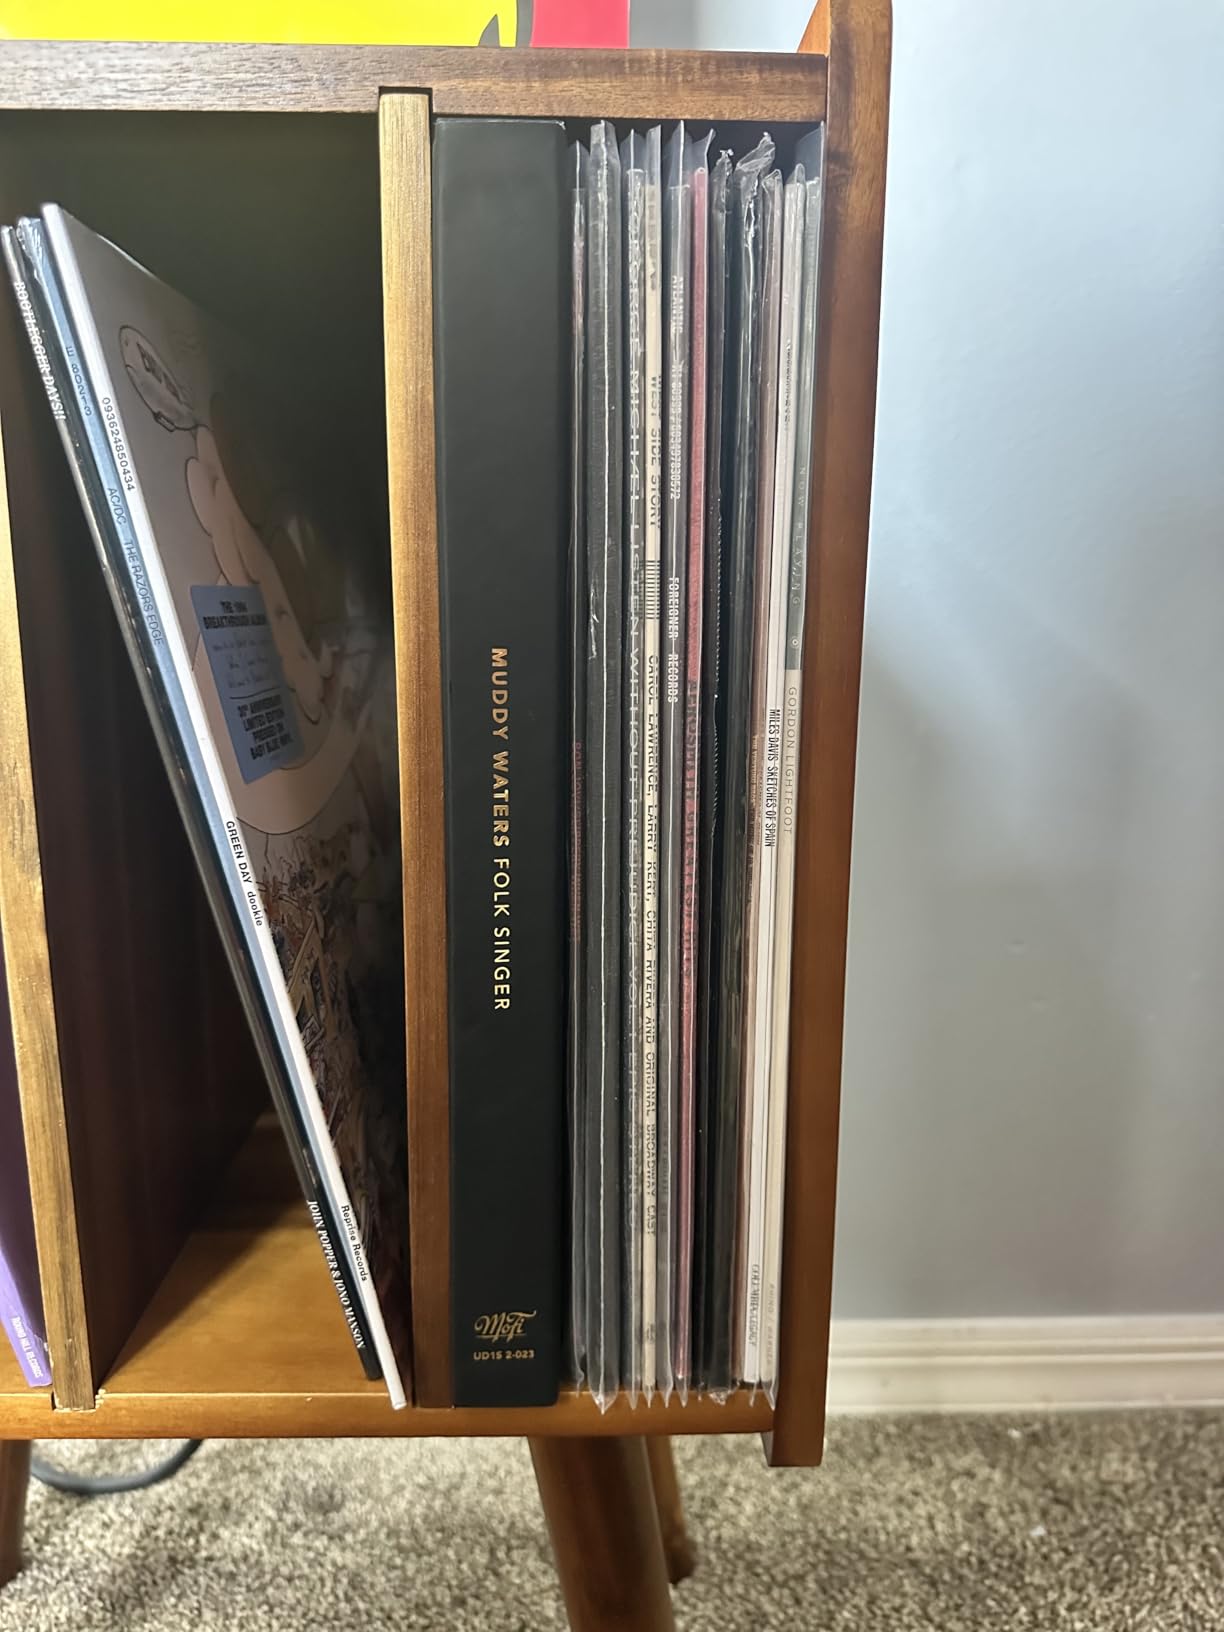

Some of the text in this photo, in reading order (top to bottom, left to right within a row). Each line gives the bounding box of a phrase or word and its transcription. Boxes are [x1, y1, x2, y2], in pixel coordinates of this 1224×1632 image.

[14, 280, 52, 375] BOOTLEGGER
[671, 275, 684, 335] ATLANTIC
[101, 397, 136, 491] 093624850434
[649, 474, 661, 529] STORY
[108, 487, 164, 646] AC/DC THE RAZORS EDGE
[667, 577, 680, 703] FOREIGNER RECORDS
[648, 654, 659, 705] CAROL
[630, 648, 639, 787] WITHOUT
[764, 709, 781, 847] MILES DAVIS SKETCHES OF SPAIN
[784, 687, 798, 836] GORDON LIGHTFOOT
[491, 648, 511, 1010] MUDDY WATERS FOLK SINGER
[647, 804, 657, 852] LARRY
[226, 820, 263, 927] GREEN DAY dookie
[646, 910, 657, 951] CHITA
[645, 960, 657, 1009] RIVERA
[645, 1016, 656, 1044] AND
[646, 1052, 656, 1117] ORIGINAL
[646, 1124, 657, 1197] BROADWAY
[341, 1204, 368, 1282] Reprise Records
[646, 1205, 656, 1237] CAST
[308, 1200, 367, 1349] JOHN POPPER & JONO MANSON
[505, 1349, 535, 1360] 2-023
